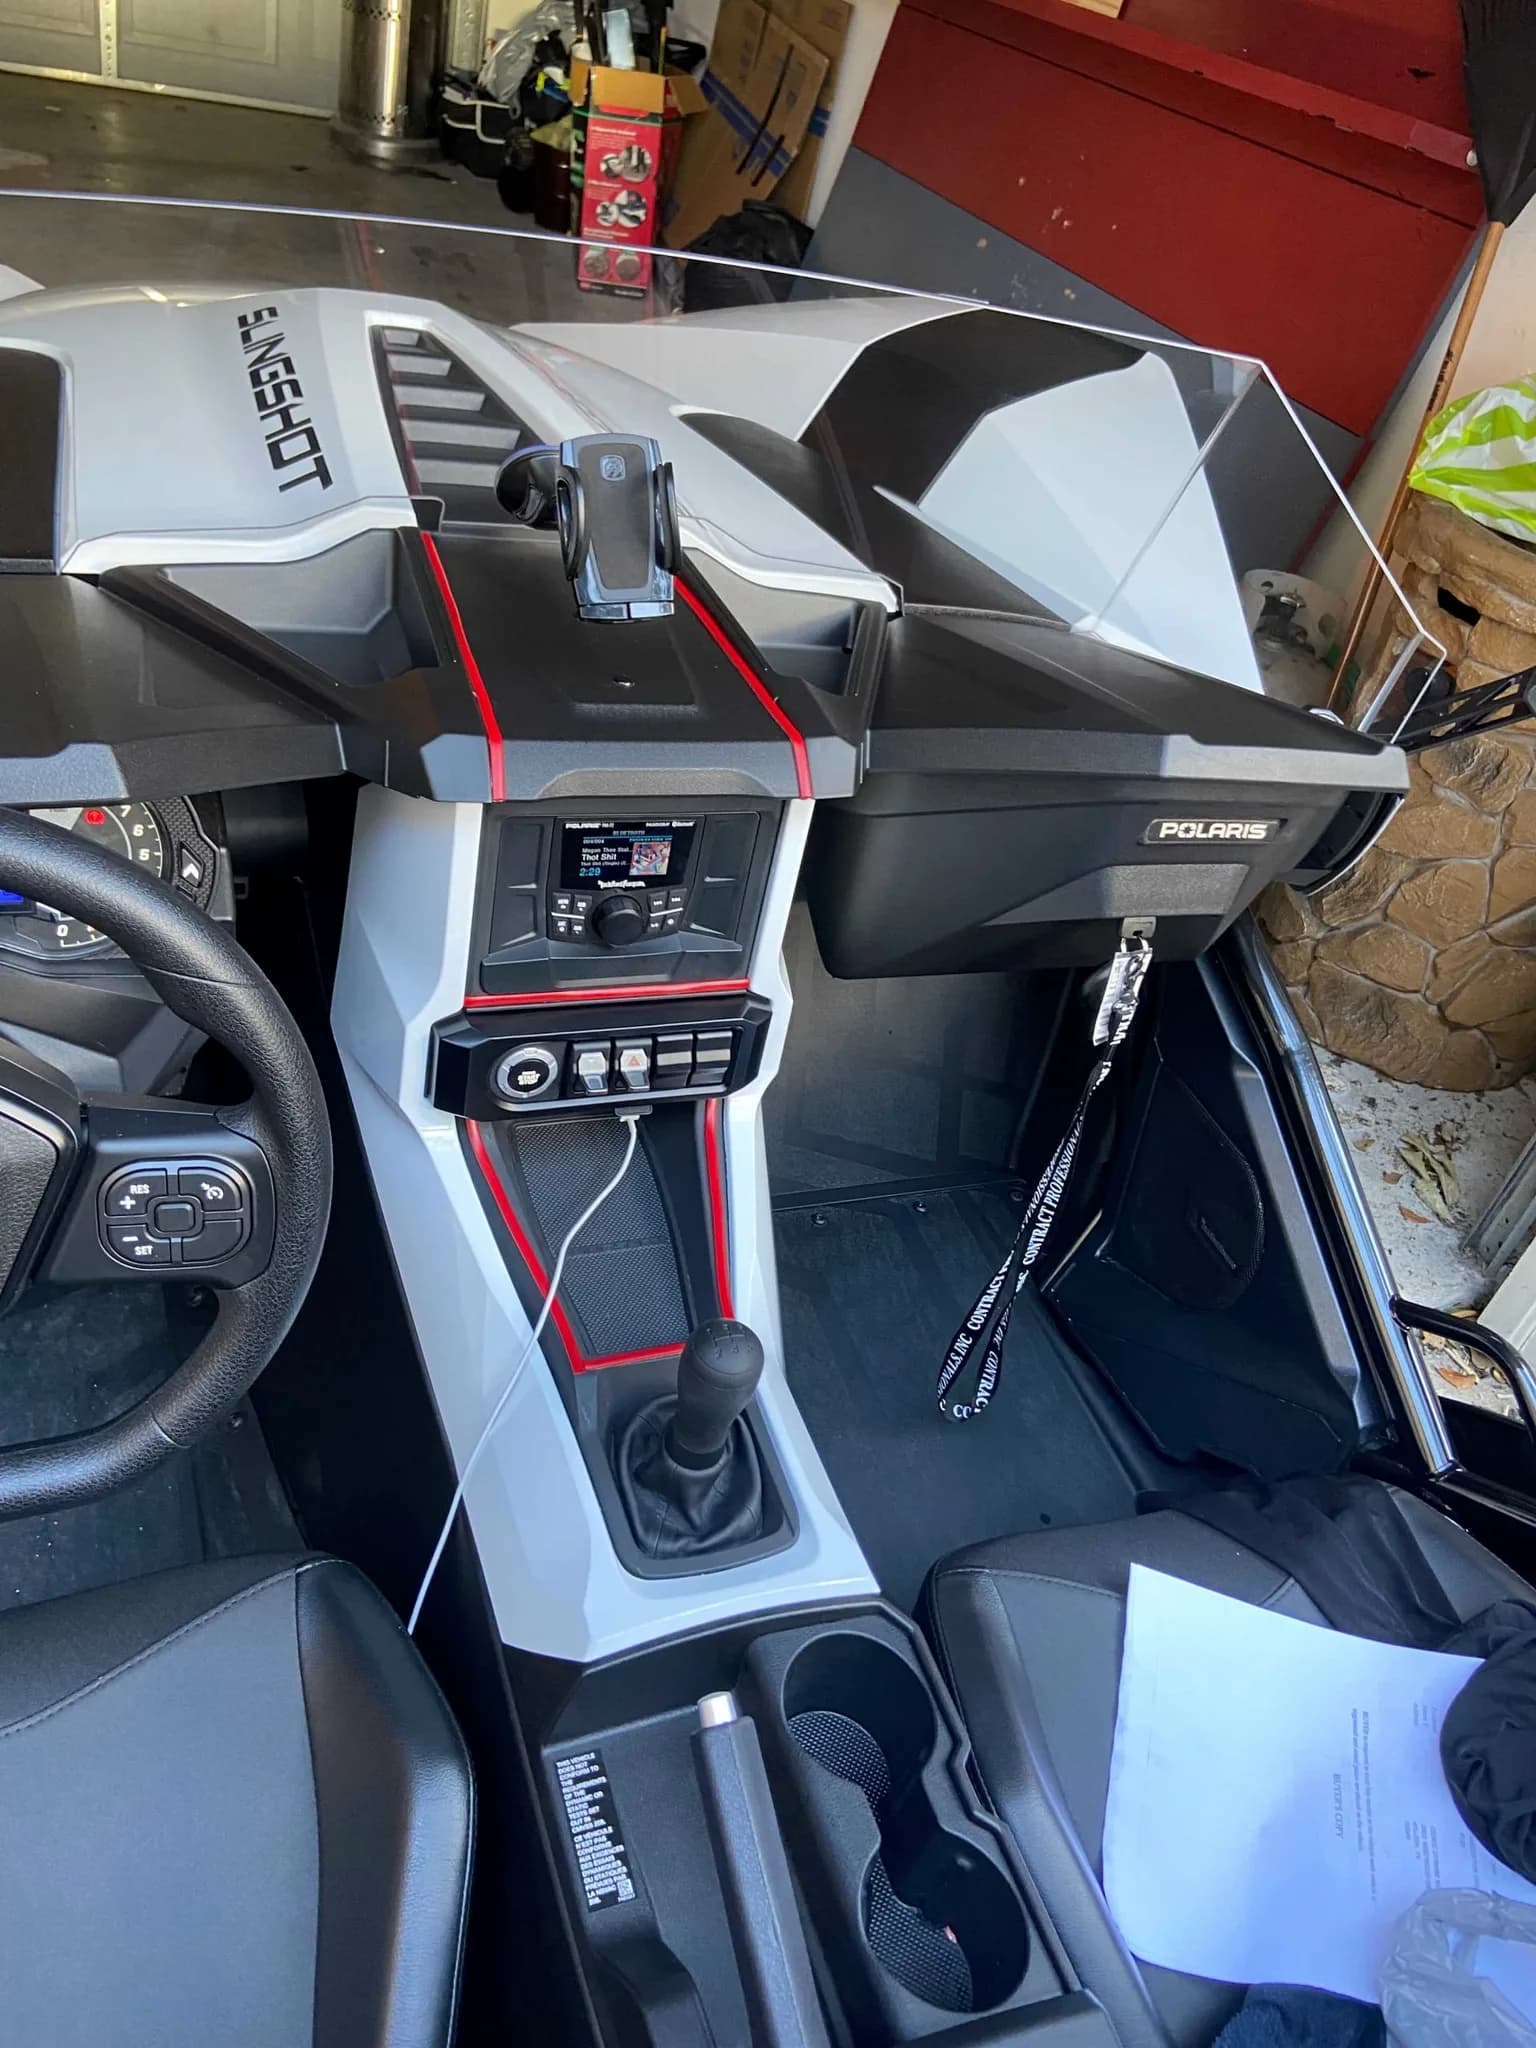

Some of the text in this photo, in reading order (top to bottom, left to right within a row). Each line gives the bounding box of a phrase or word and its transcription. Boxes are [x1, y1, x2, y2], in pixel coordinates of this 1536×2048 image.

[237, 306, 333, 493] SLINGSHOT
[120, 805, 131, 818] 7
[132, 824, 145, 837] 6
[1159, 822, 1268, 839] POLARIS
[139, 848, 151, 862] 5
[581, 853, 599, 861] Thot
[56, 924, 69, 937] 0
[130, 1184, 150, 1195] RES
[1022, 1205, 1056, 1266] CONTRACT
[134, 1245, 154, 1256] SET
[590, 1764, 600, 1773] TO
[587, 1890, 596, 1899] LA
